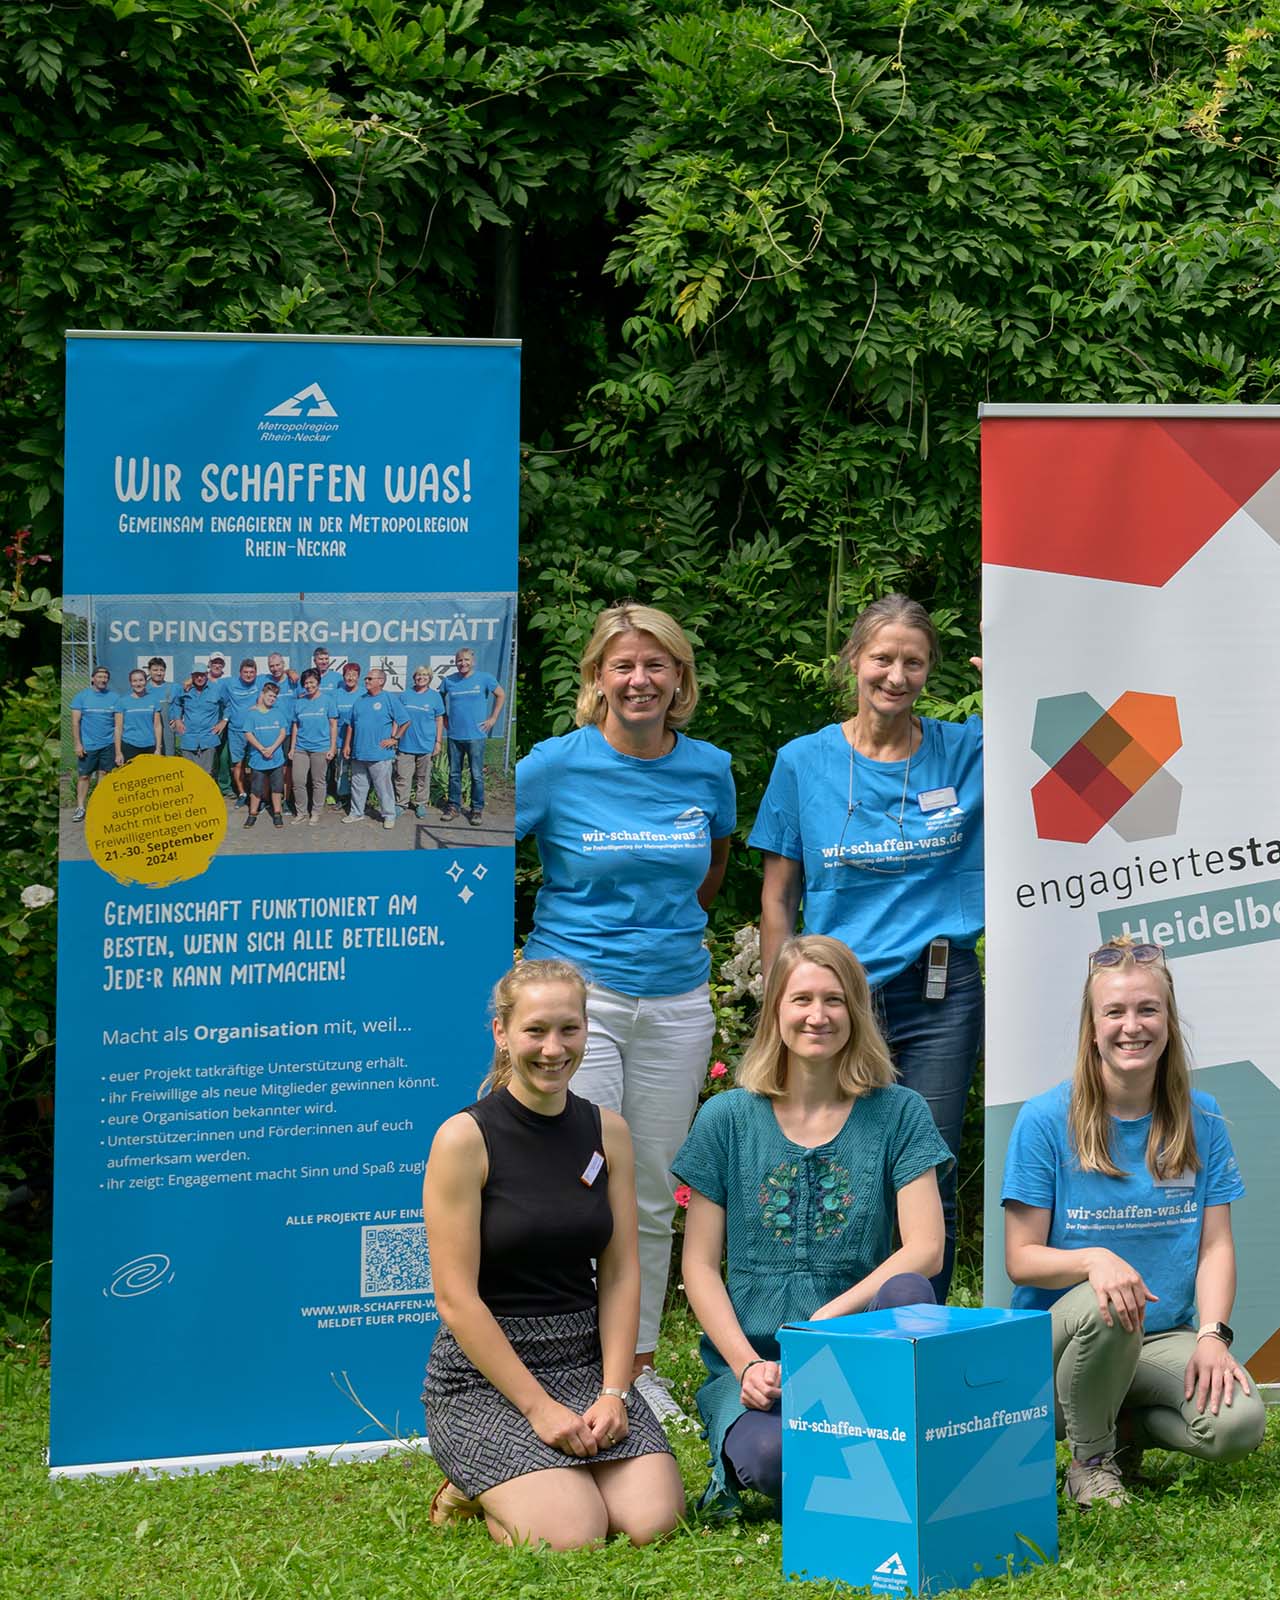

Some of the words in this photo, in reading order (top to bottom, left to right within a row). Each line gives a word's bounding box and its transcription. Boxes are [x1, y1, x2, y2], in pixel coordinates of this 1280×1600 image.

[257, 421, 339, 433] Metropolregion
[260, 432, 331, 442] Rhein-Neckar
[109, 621, 141, 642] SC
[148, 614, 499, 644] PFINGSTBERG-HOCHSTÄTT
[112, 770, 184, 793] Engagement
[117, 786, 159, 805] einfach
[162, 782, 184, 796] mal
[103, 818, 139, 834] Macht
[142, 815, 162, 827] mit
[164, 810, 182, 823] bei
[185, 806, 207, 818] den
[111, 794, 194, 820] ausprobieren?
[95, 823, 192, 850] Freiwilligentagen
[194, 818, 220, 830] vom
[105, 845, 145, 861] 21.-30.
[147, 832, 214, 854] September
[822, 832, 963, 858] wir-schaffen-was.de
[146, 852, 178, 866] 2024!
[103, 1027, 158, 1045] Macht
[163, 1026, 188, 1042] als
[194, 1021, 318, 1044] Organisation
[324, 1019, 357, 1035] mit,
[362, 1016, 411, 1033] weil...
[109, 1072, 140, 1082] euer
[144, 1067, 192, 1082] Projekt
[195, 1063, 264, 1078] tatkräftige
[268, 1060, 363, 1074] Unterstützung
[366, 1056, 407, 1069] erhält.
[109, 1092, 127, 1104] ihr
[131, 1088, 198, 1103] Freiwillige
[201, 1087, 220, 1099] als
[224, 1087, 257, 1097] neue
[261, 1081, 327, 1098] Mitglieder
[330, 1080, 394, 1095] gewinnen
[398, 1077, 439, 1088] könnt.
[108, 1114, 139, 1125] eure
[142, 1108, 229, 1125] Organisation
[233, 1106, 301, 1118] bekannter
[304, 1101, 336, 1114] wird.
[108, 1130, 235, 1147] Unterstützer:innen
[239, 1126, 265, 1139] und
[269, 1124, 353, 1137] Förder:innen
[356, 1120, 379, 1133] auf
[381, 1119, 413, 1131] euch
[107, 1154, 192, 1168] aufmerksam
[195, 1150, 250, 1163] werden.
[107, 1178, 125, 1189] ihr
[129, 1176, 164, 1190] zeigt:
[168, 1172, 252, 1188] Engagement
[256, 1168, 297, 1180] macht
[301, 1166, 329, 1178] Sinn
[333, 1163, 358, 1176] und
[362, 1161, 395, 1176] Spaß
[399, 1160, 425, 1175] zugl
[286, 1215, 313, 1226] ALLE
[317, 1211, 371, 1224] PROJEKTE
[374, 1210, 397, 1220] AUF
[400, 1209, 424, 1219] EINE
[1067, 1200, 1198, 1220] wir-schaffen-was.de
[301, 1298, 436, 1317] WWW.WIR-SCHAFFEN-W
[318, 1316, 363, 1328] MELDET
[366, 1315, 394, 1325] EUER
[398, 1311, 439, 1324] PROJEK
[788, 1416, 907, 1443] wir-schaffen-was.de
[925, 1404, 1049, 1442] #wirschaffenwas
